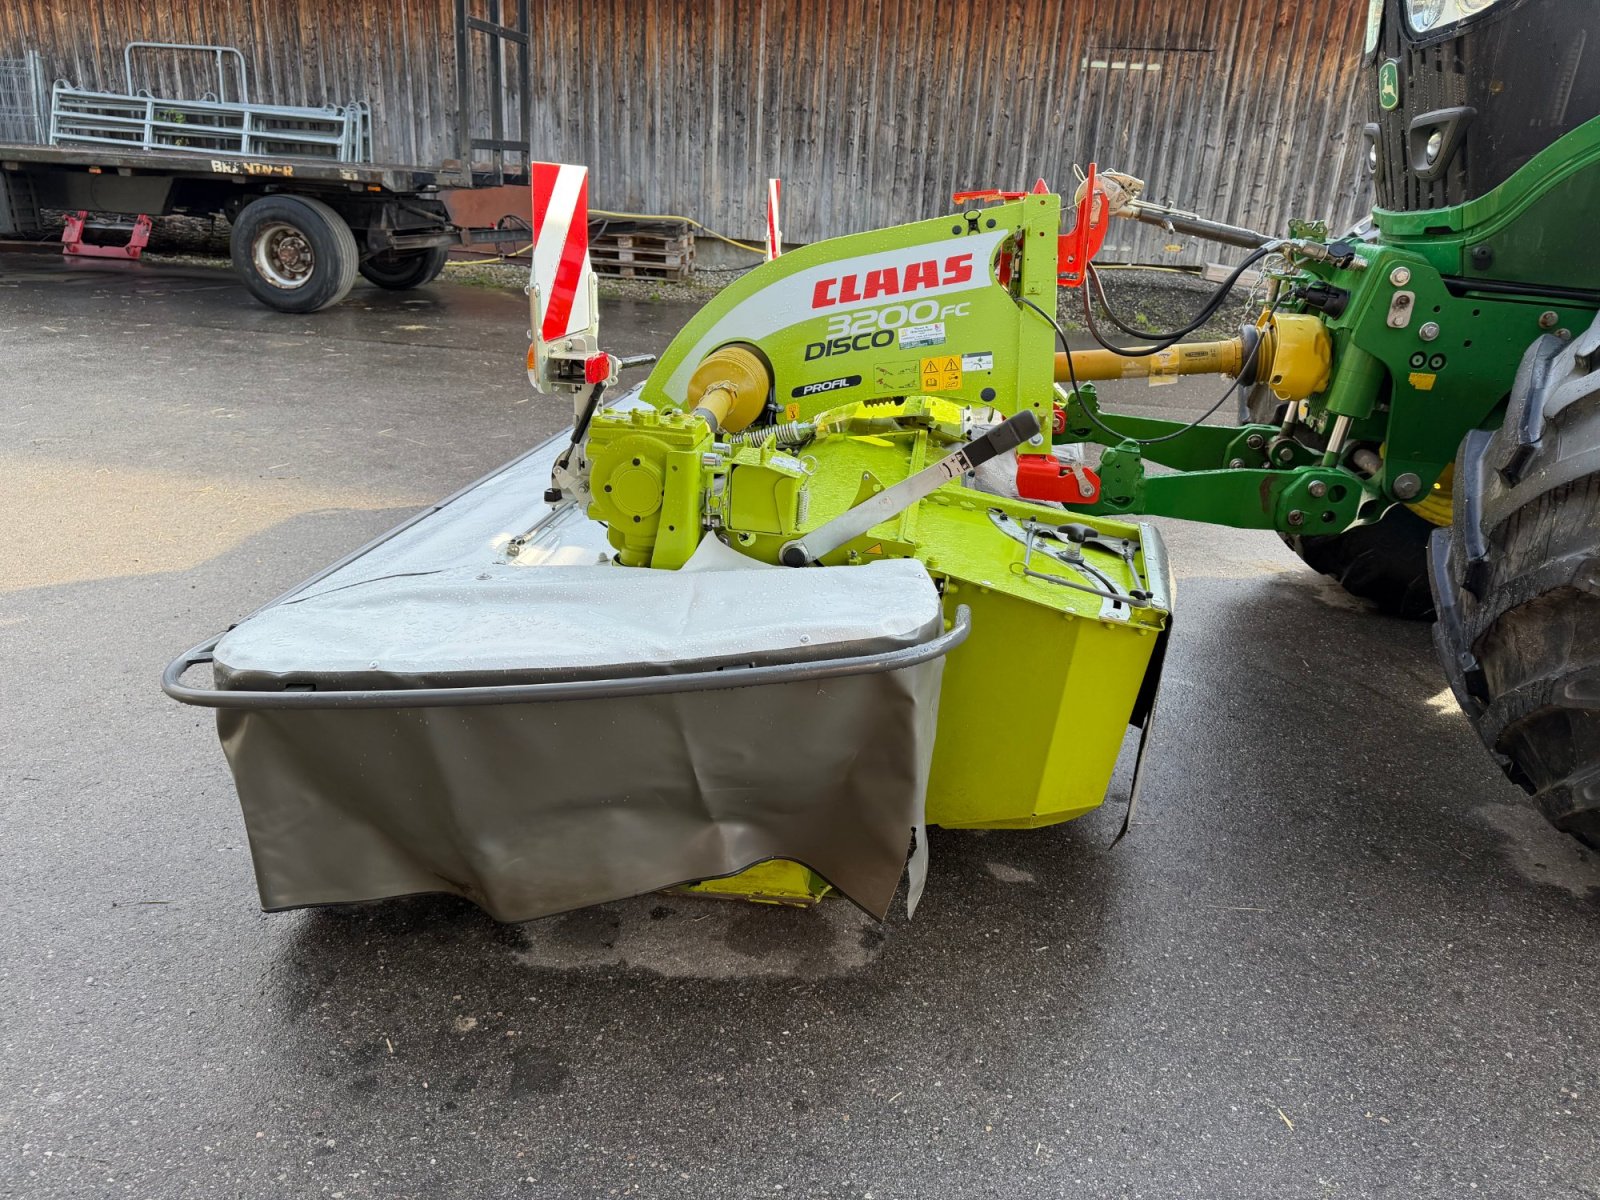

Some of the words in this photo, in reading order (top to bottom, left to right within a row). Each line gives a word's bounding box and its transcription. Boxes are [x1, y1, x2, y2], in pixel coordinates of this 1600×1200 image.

[812, 253, 973, 309] CLAAS
[804, 329, 895, 362] DISCO
[803, 377, 850, 395] PROFIL
